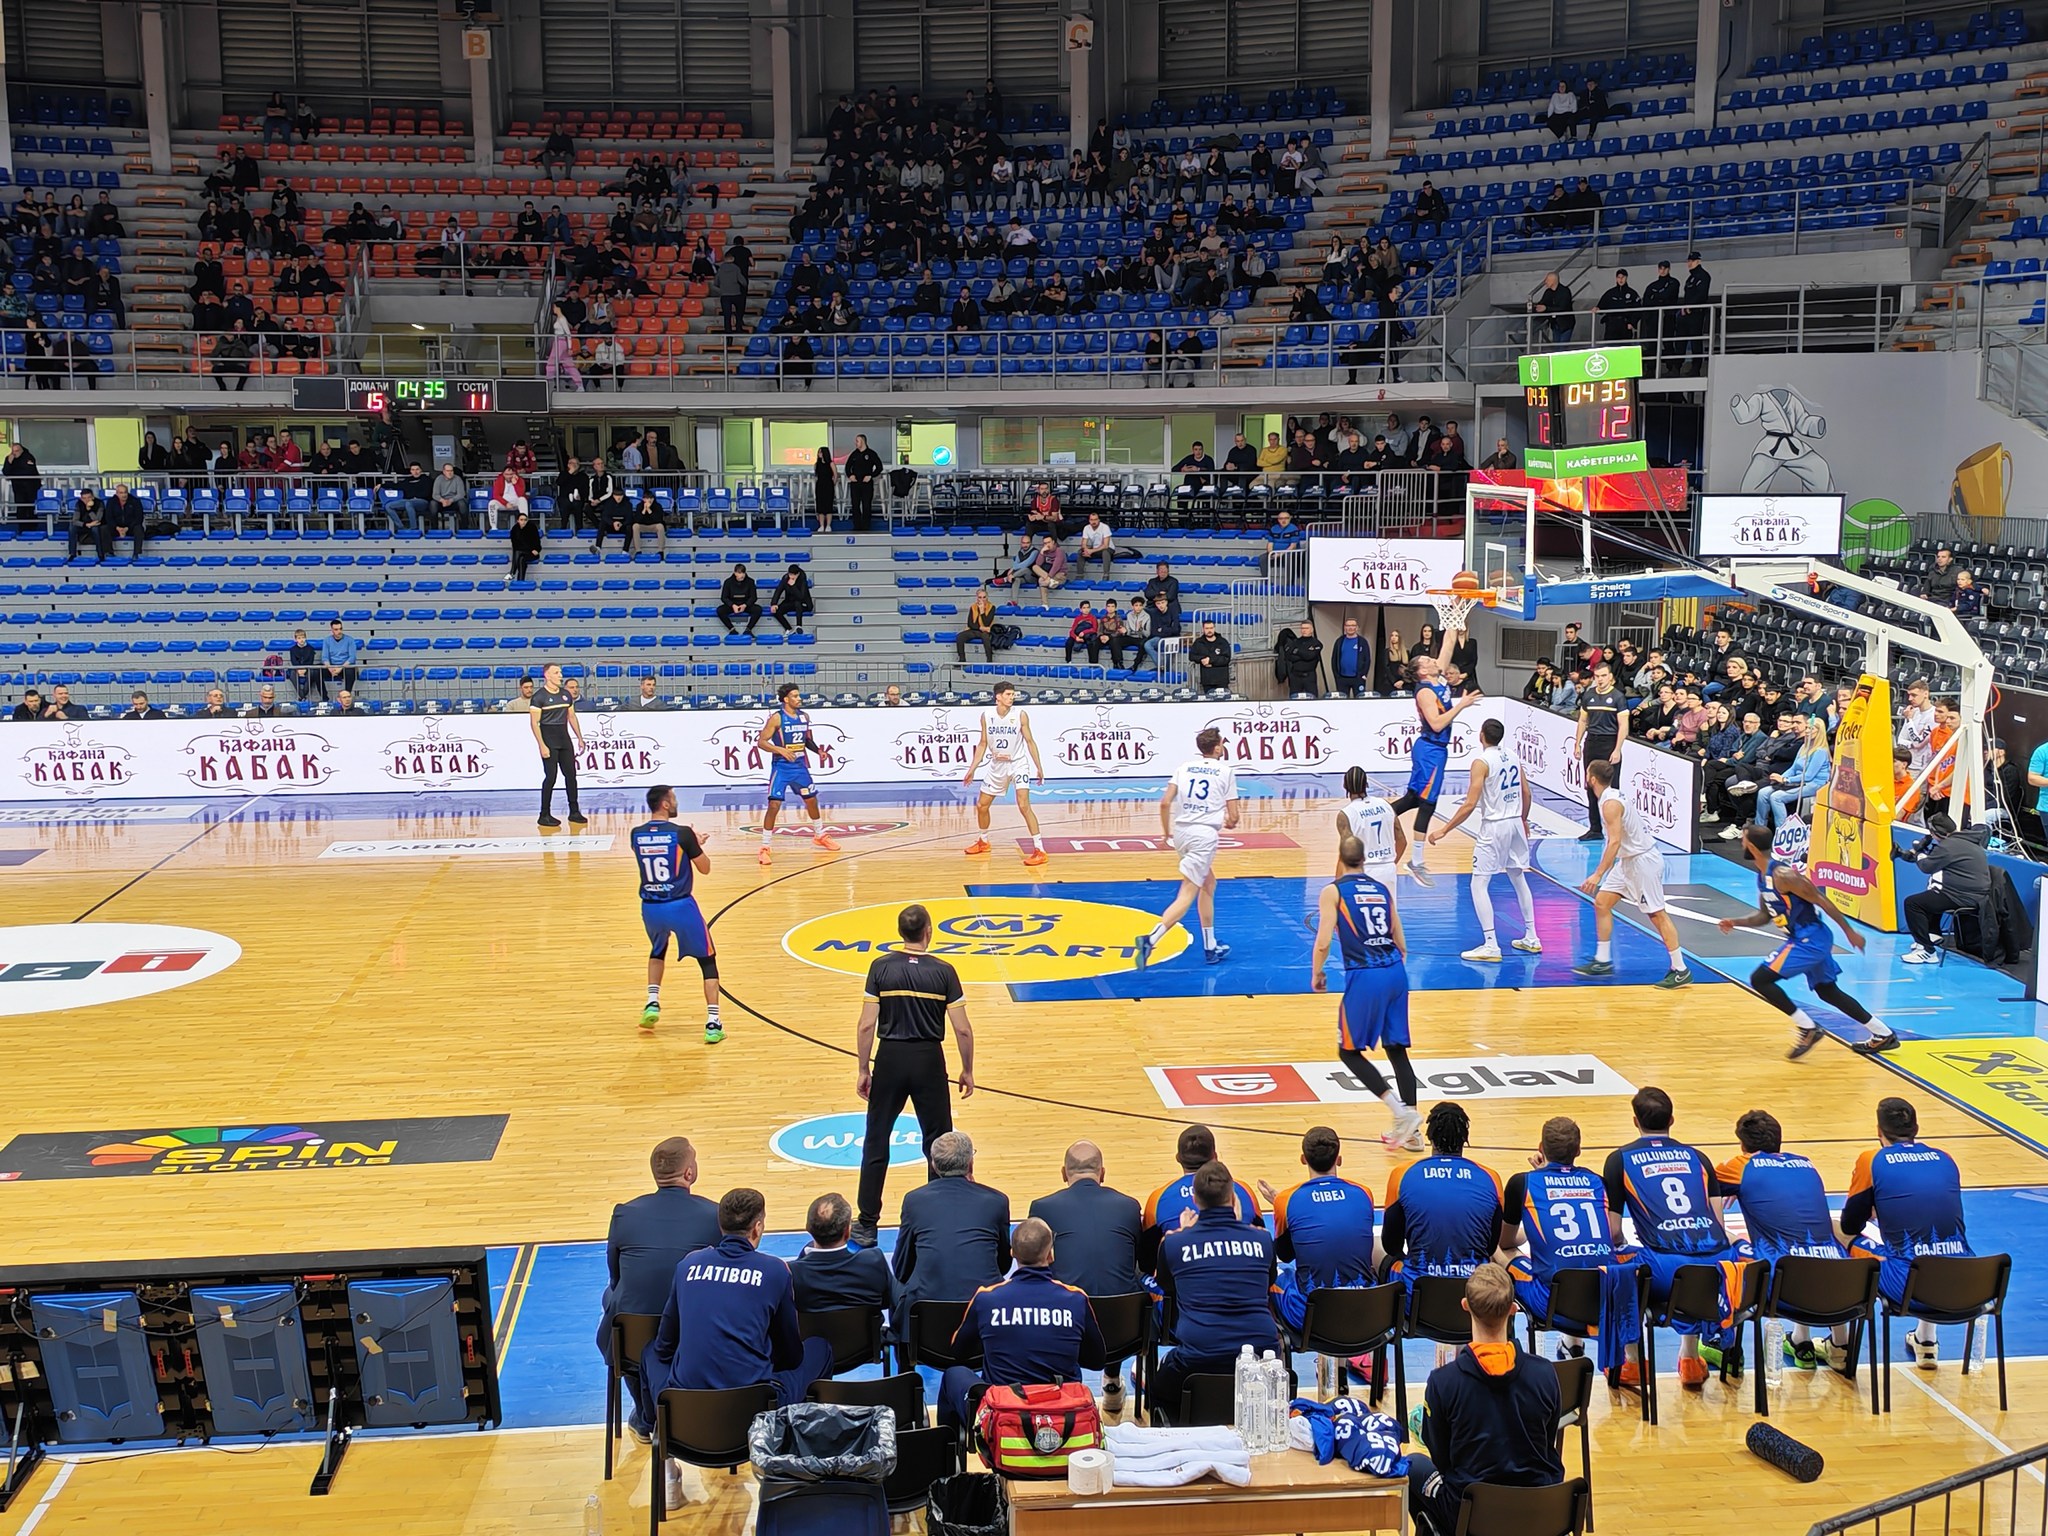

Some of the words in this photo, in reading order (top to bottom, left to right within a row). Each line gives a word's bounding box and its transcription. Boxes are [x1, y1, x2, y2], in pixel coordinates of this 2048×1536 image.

[468, 34, 485, 56] B
[350, 381, 389, 392] ДОМАЋИ
[457, 382, 488, 392] ГОСТИ
[367, 392, 383, 410] 15
[471, 394, 487, 409] 11
[1600, 406, 1631, 439] 12
[1566, 455, 1639, 469] КАФЕТЕРИЈА
[1741, 527, 1801, 541] КАБАК
[1351, 572, 1420, 591] КАБАК
[1590, 582, 1631, 591] Schelde
[1590, 589, 1631, 599] Sports
[1823, 605, 1850, 619] Sports
[792, 732, 804, 743] 22
[988, 726, 1017, 735] SPARTAK
[996, 739, 1008, 749] 20
[1068, 742, 1147, 761] КАБАК
[35, 762, 122, 781] КАБАК
[201, 754, 322, 781] КАБАК
[395, 754, 480, 774] КАБАК
[1016, 774, 1029, 783] 20
[1500, 765, 1520, 790] 22
[1187, 779, 1209, 800] 13
[1359, 805, 1386, 819] HANLAN
[1370, 821, 1382, 844] 7
[1774, 826, 1809, 852] Logex
[642, 857, 670, 882] 16
[1818, 868, 1832, 880] 270
[1833, 870, 1867, 888] GODINA
[1360, 906, 1388, 935] 13
[152, 1163, 272, 1174] SLOT
[282, 1157, 392, 1168] CLUB
[1424, 1167, 1453, 1179] LACY
[1456, 1168, 1472, 1179] JR
[1661, 1177, 1692, 1215] 8
[1550, 1202, 1602, 1241] 31
[1181, 1240, 1265, 1263] ZLATIBOR
[687, 1265, 763, 1287] ZLATIBOR
[990, 1308, 1073, 1328] ZLATIBOR
